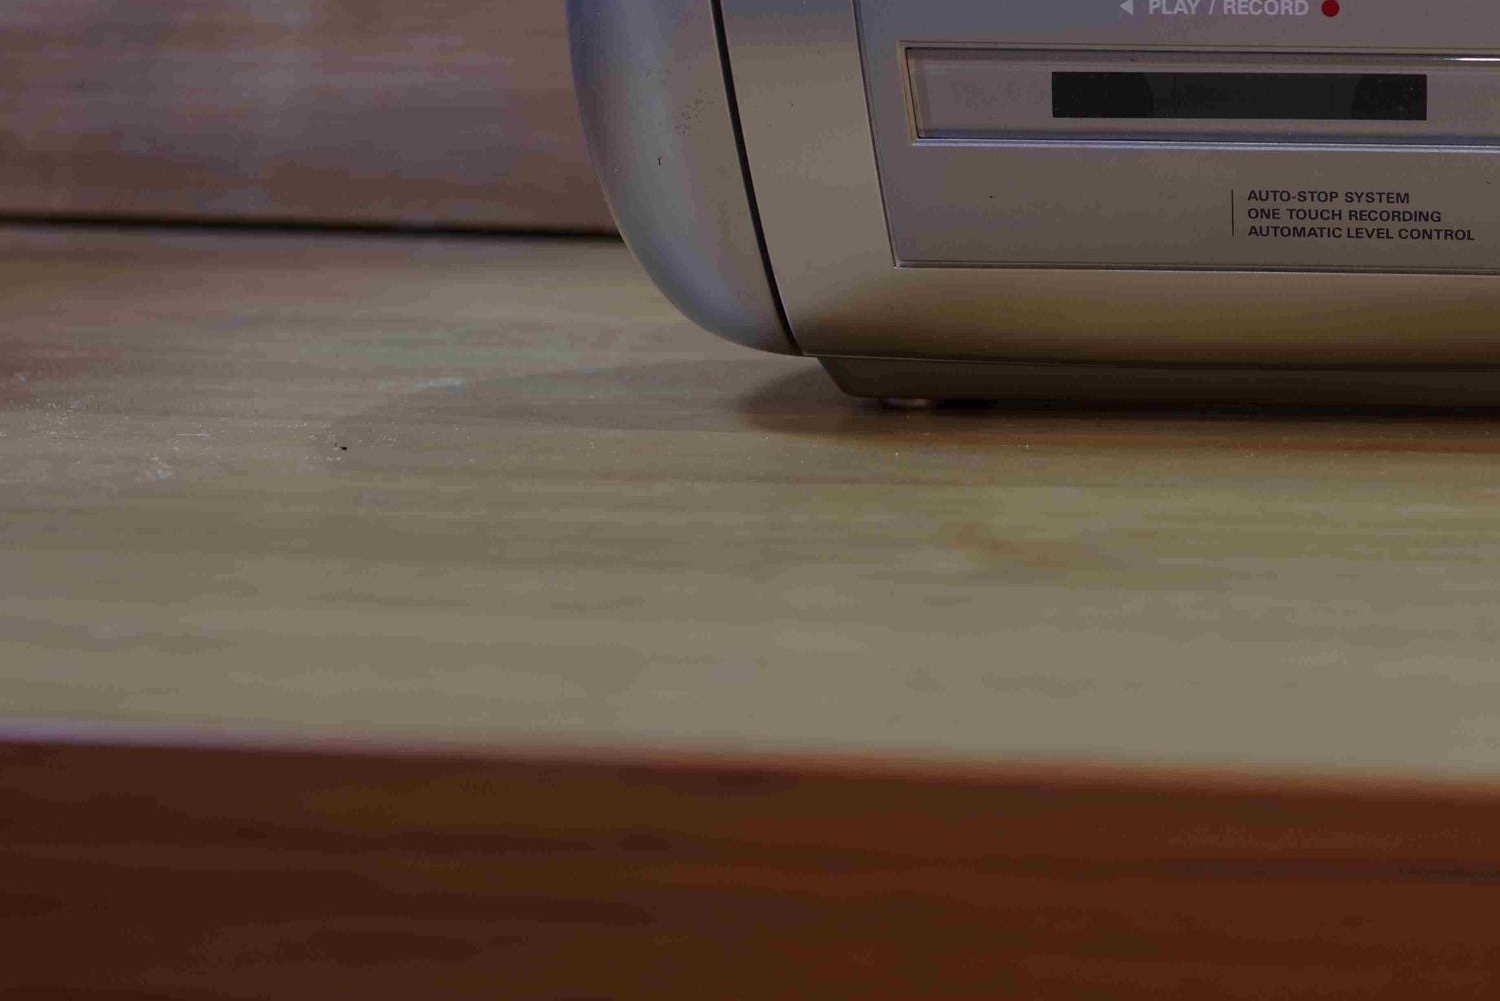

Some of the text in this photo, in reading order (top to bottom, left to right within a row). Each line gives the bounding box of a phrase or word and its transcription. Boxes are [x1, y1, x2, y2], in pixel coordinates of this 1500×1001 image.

[1223, 0, 1309, 16] RECORD
[1247, 190, 1410, 204] AUTO-STOP SYSTEM
[1247, 207, 1442, 223] ONE TOUCH RECORDING
[1247, 225, 1475, 241] AUTOMATIC LEVEL CONTROL
